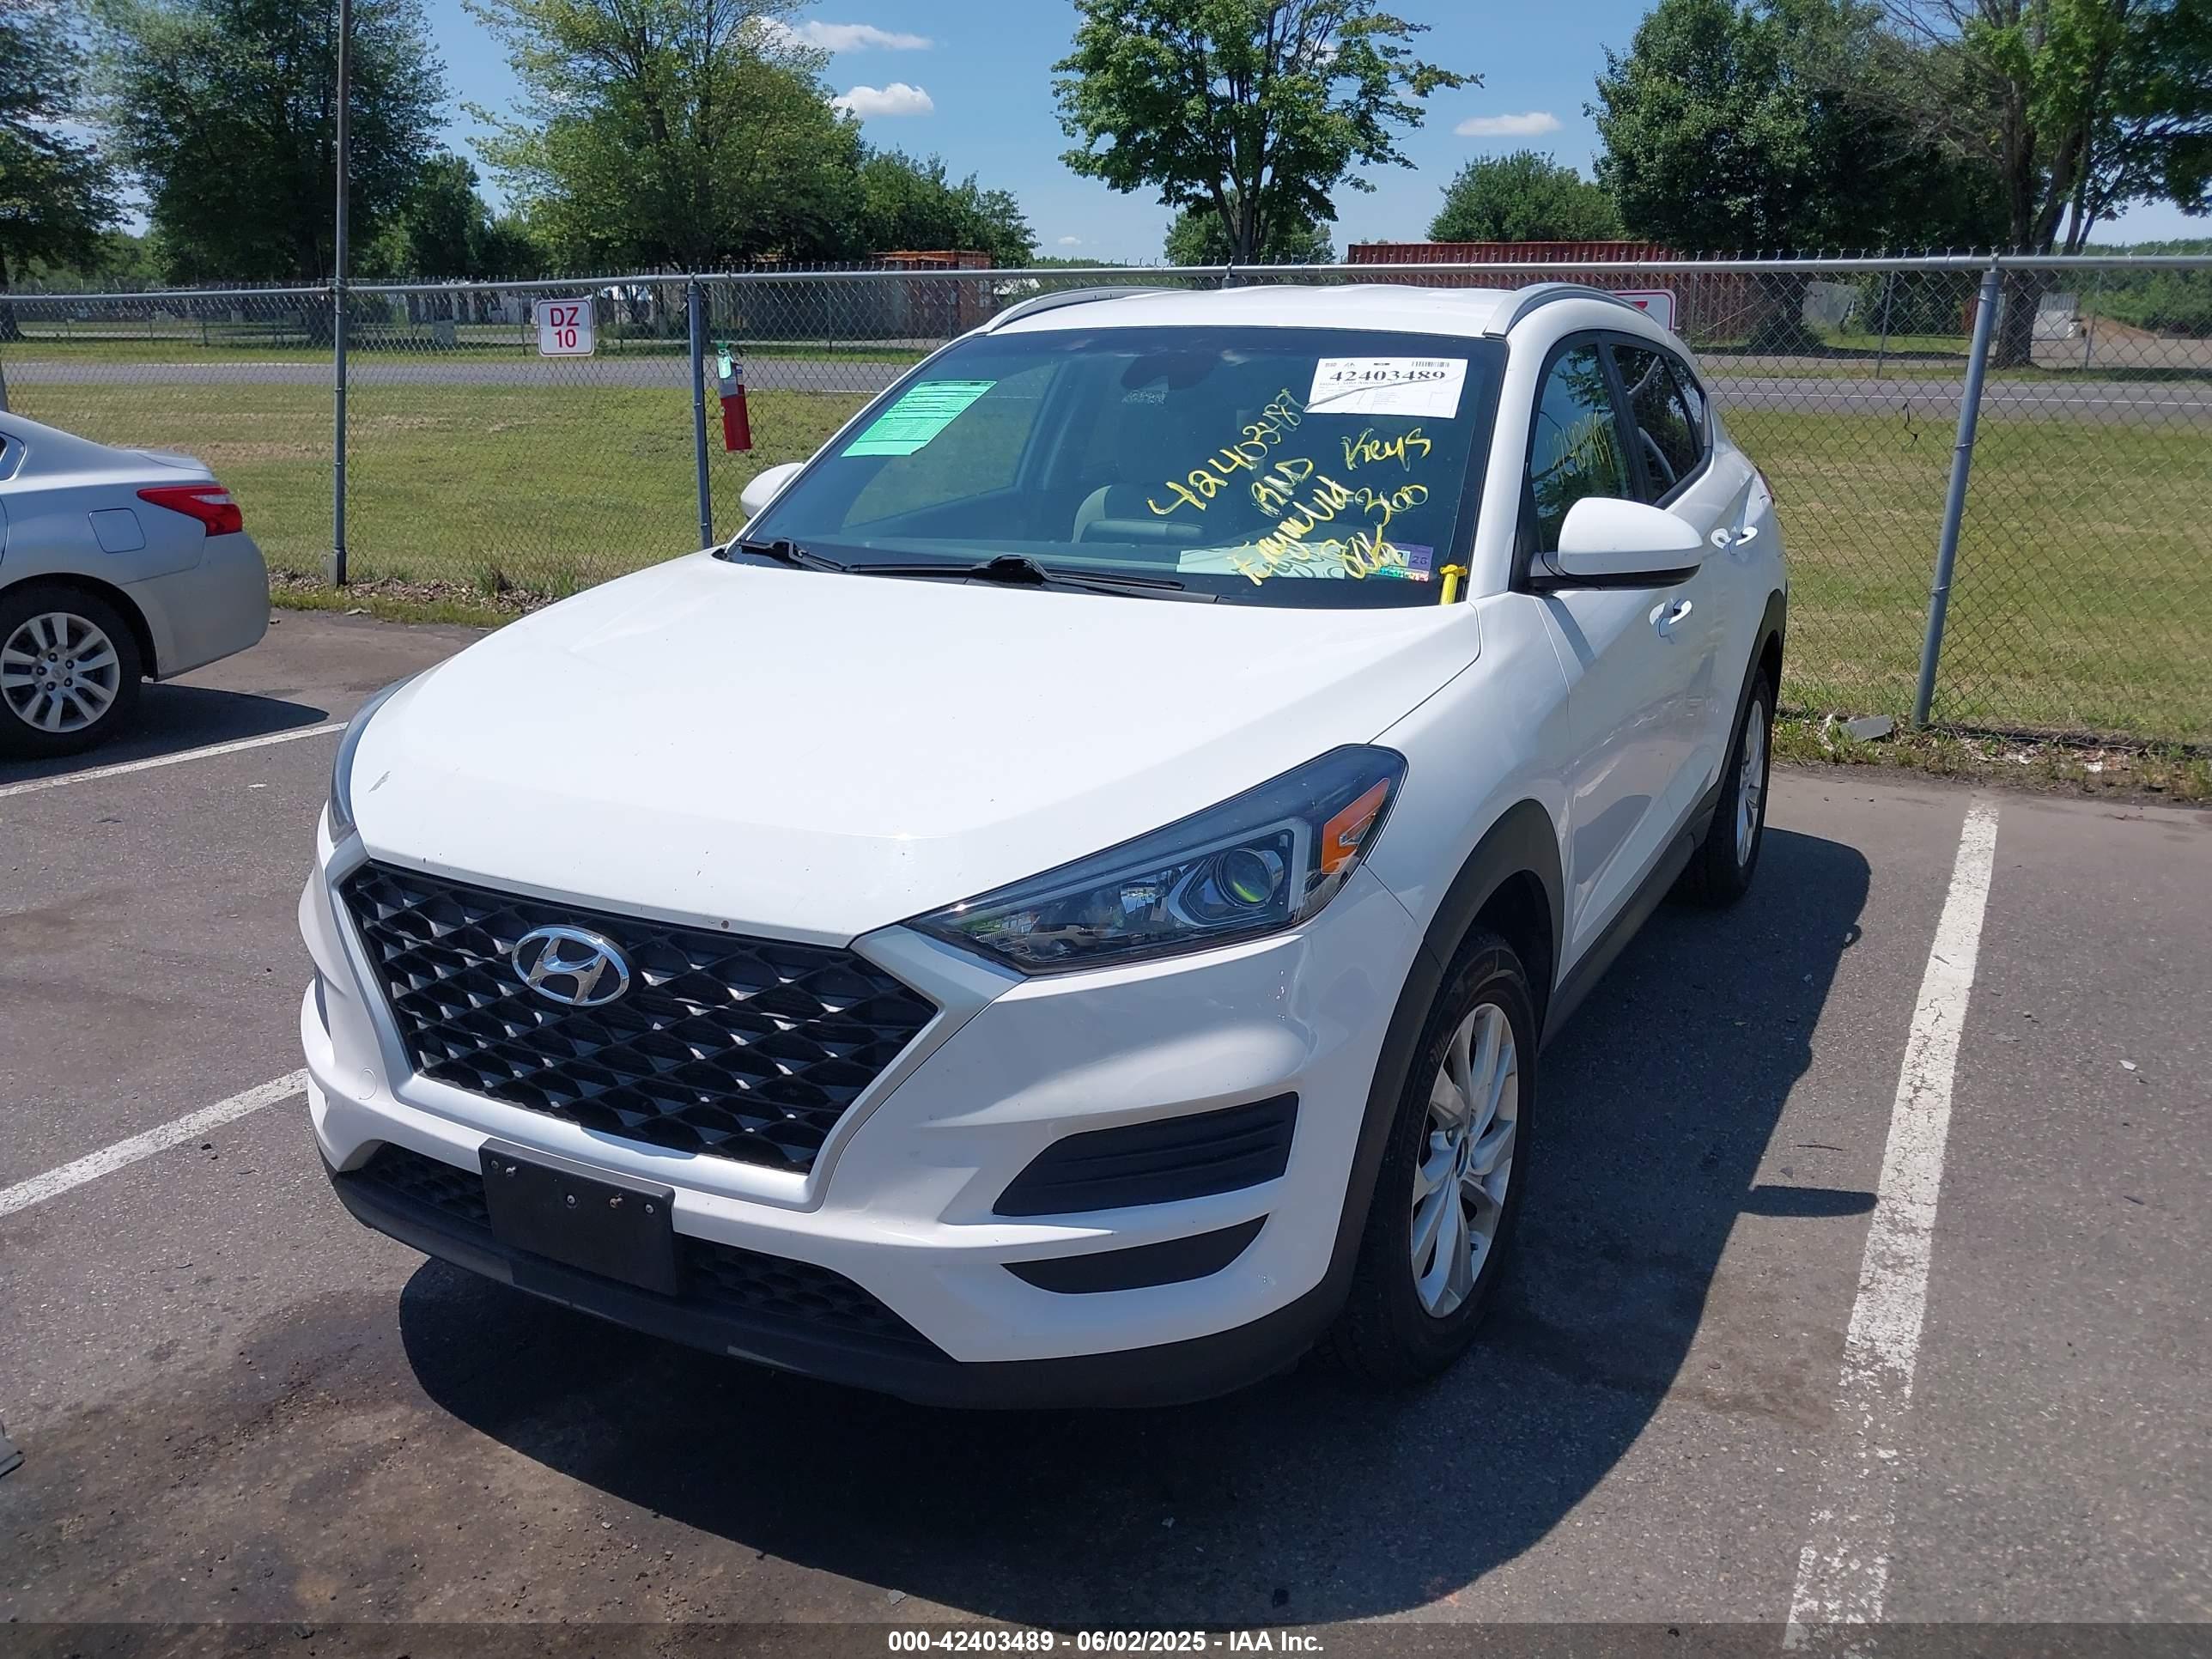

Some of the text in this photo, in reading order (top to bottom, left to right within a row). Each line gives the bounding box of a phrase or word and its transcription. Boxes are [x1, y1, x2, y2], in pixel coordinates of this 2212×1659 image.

[550, 307, 580, 327] DZ
[555, 329, 576, 348] 10
[1329, 370, 1446, 381] 42403489
[1146, 388, 1305, 515] 42403489
[1340, 428, 1432, 472] Keys
